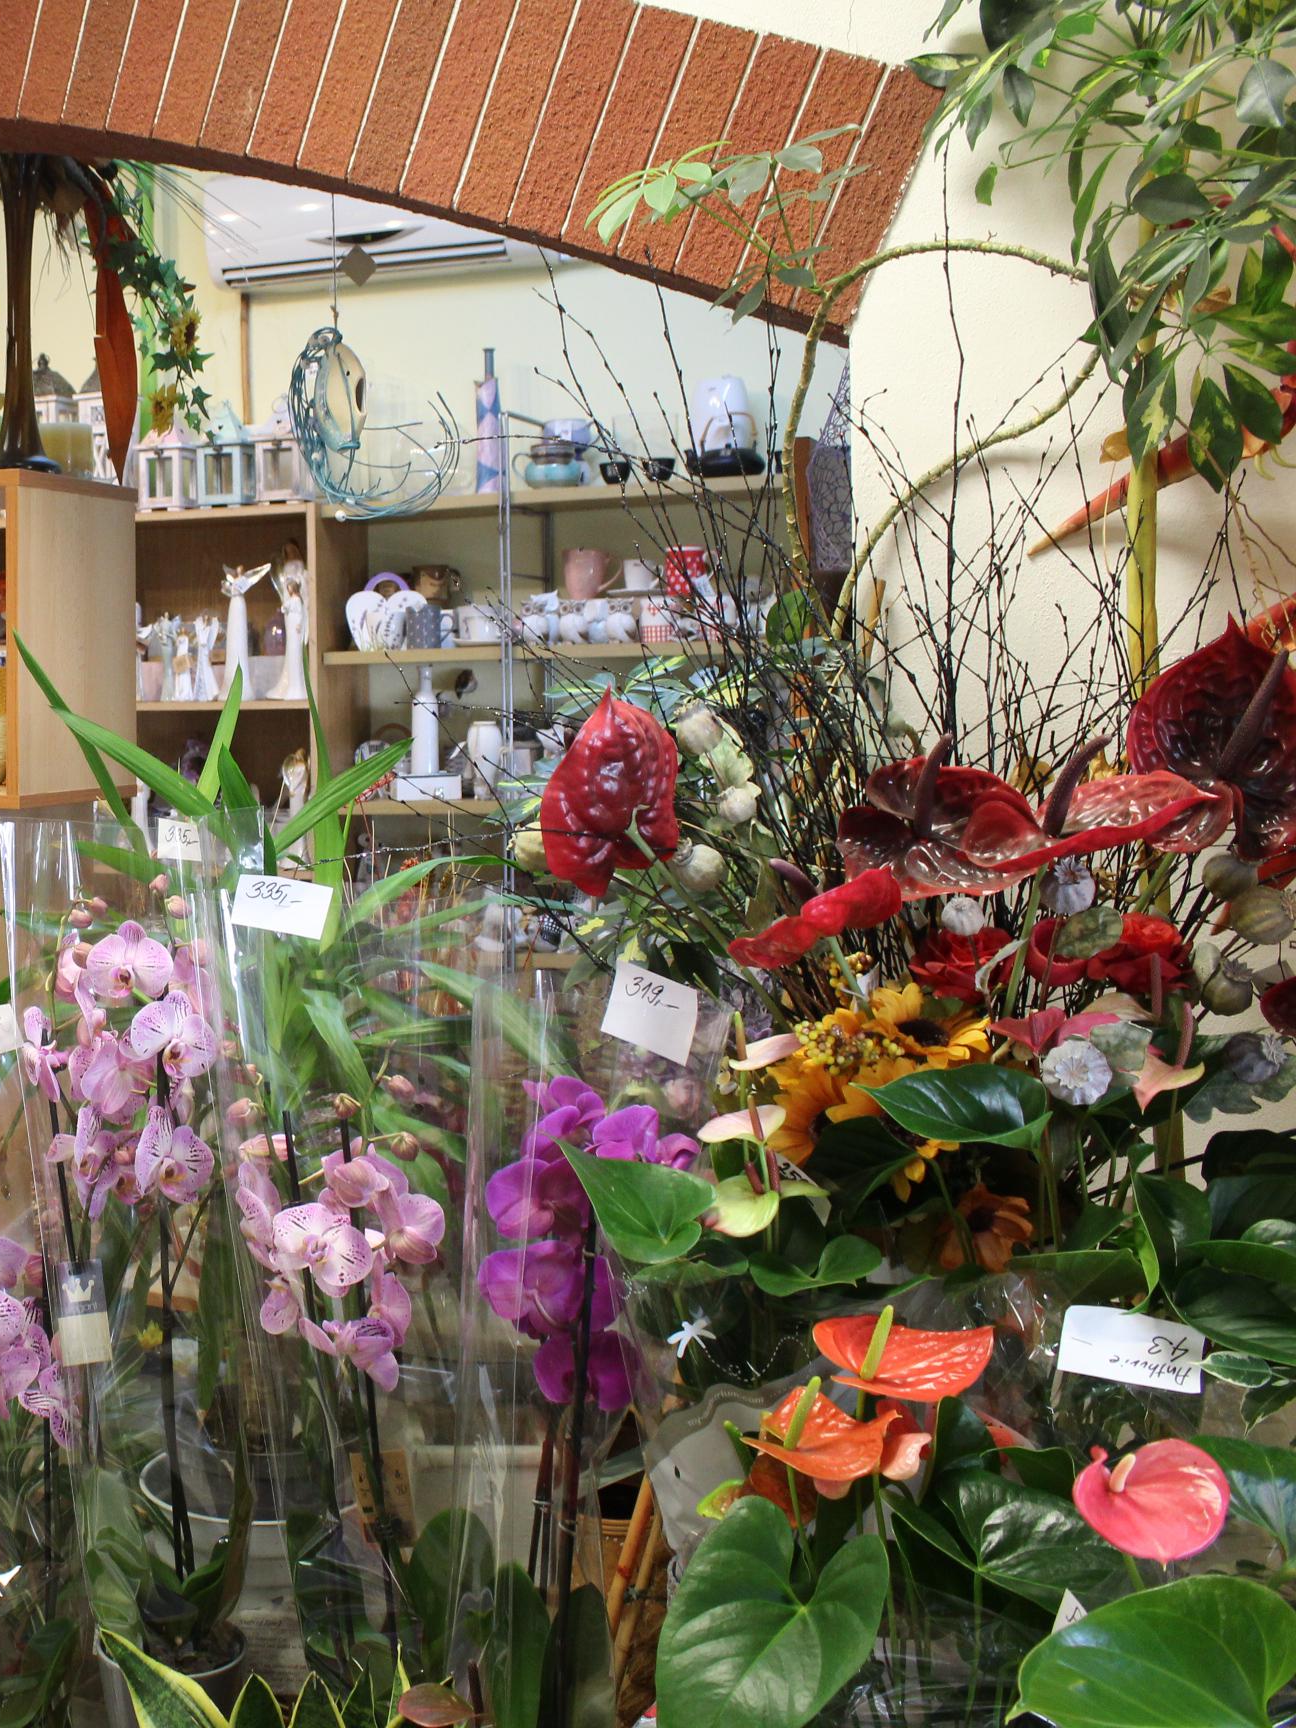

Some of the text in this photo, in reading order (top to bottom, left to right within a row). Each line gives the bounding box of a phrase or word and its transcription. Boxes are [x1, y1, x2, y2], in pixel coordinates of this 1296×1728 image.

[245, 881, 304, 905] 335,-
[625, 976, 680, 1010] 319,-
[1147, 1335, 1190, 1362] 43
